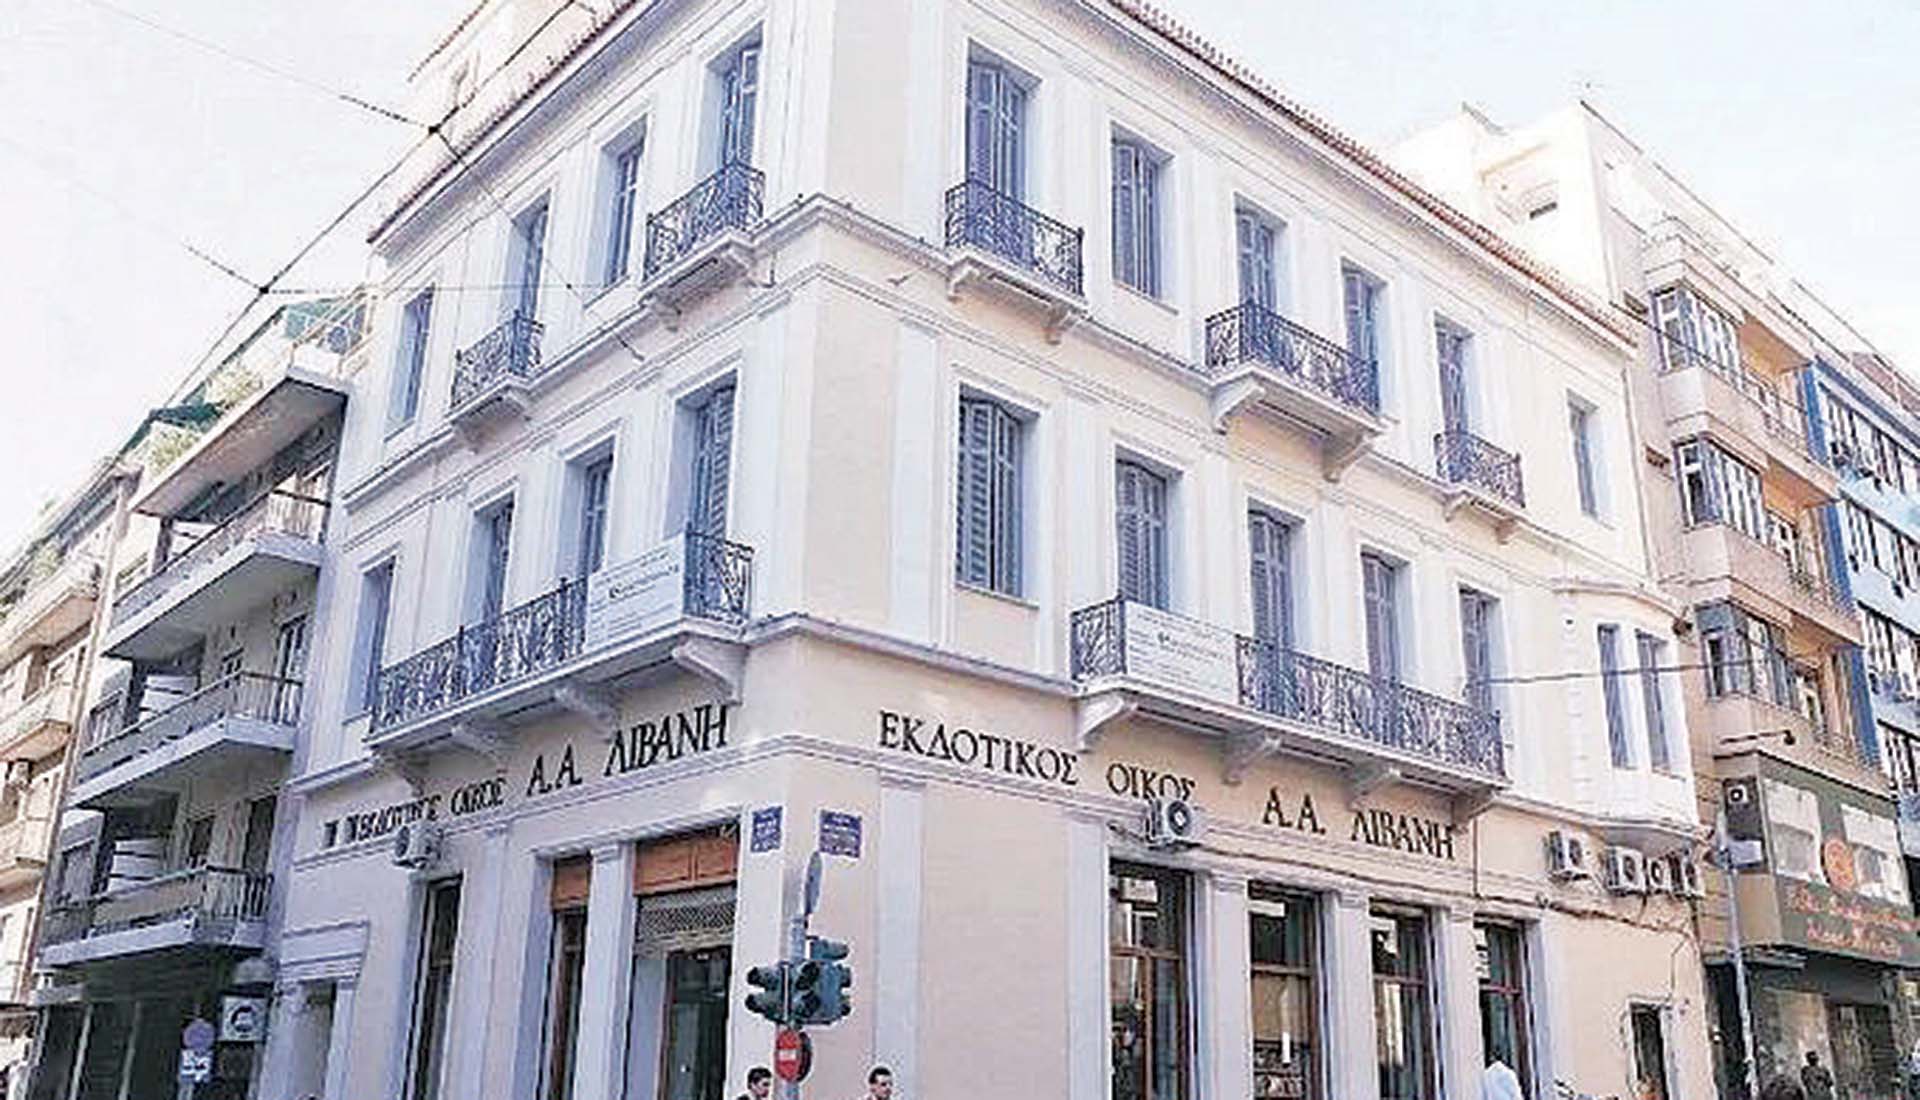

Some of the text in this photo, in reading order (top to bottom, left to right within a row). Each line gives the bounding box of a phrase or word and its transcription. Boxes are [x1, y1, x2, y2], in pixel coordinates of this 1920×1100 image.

[603, 703, 728, 777] ΛΙΒΑΝΗ
[879, 710, 1079, 786] ΕΚΔΟΤΙΚΟΣ
[1351, 808, 1457, 861] ΛΙΒΑΝΗ
